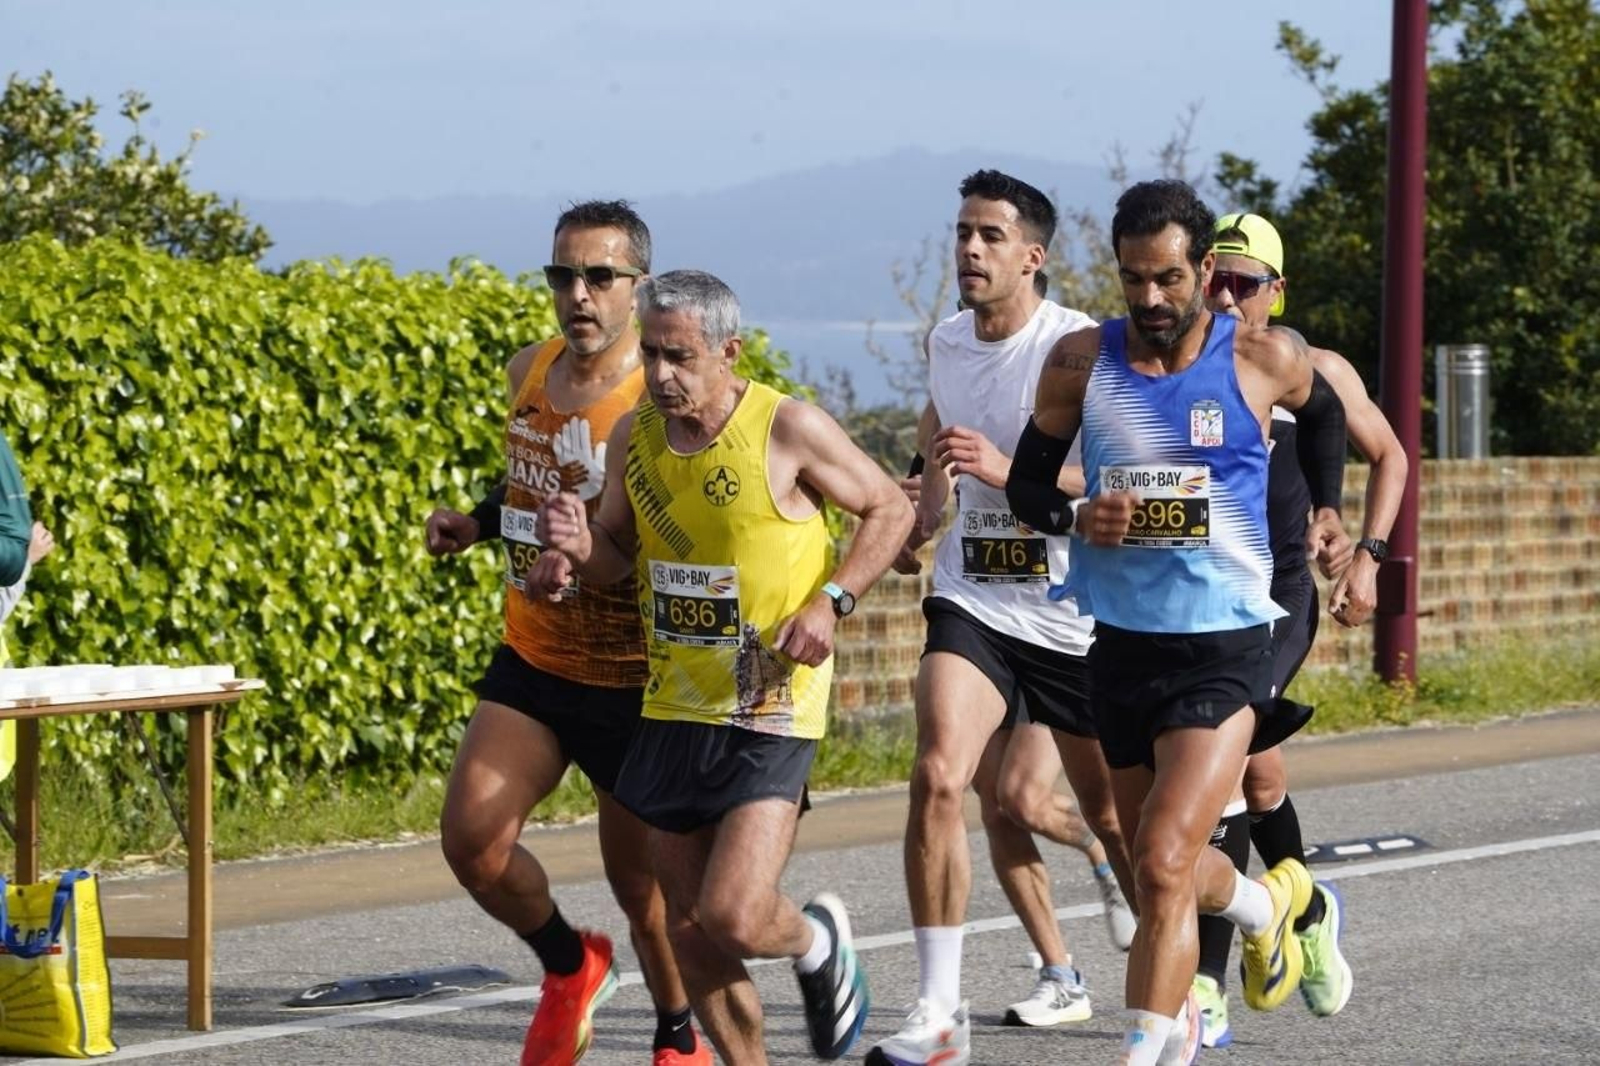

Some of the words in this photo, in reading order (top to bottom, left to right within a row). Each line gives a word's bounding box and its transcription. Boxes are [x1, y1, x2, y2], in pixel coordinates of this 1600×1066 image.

[515, 445, 551, 467] BOAS
[716, 468, 728, 482] A
[1111, 474, 1124, 489] 25
[1130, 471, 1150, 487] VIG
[1157, 471, 1182, 487] BAY
[705, 481, 716, 496] C
[725, 481, 737, 496] C
[715, 496, 725, 505] 11
[518, 514, 534, 531] VIG
[968, 516, 978, 530] 25
[982, 513, 997, 527] VIG
[1131, 500, 1186, 528] 596
[513, 543, 541, 570] 59
[981, 540, 1027, 567] 716
[656, 570, 666, 585] 25
[669, 568, 685, 584] VIG
[690, 570, 711, 586] BAY
[670, 598, 716, 628] 636
